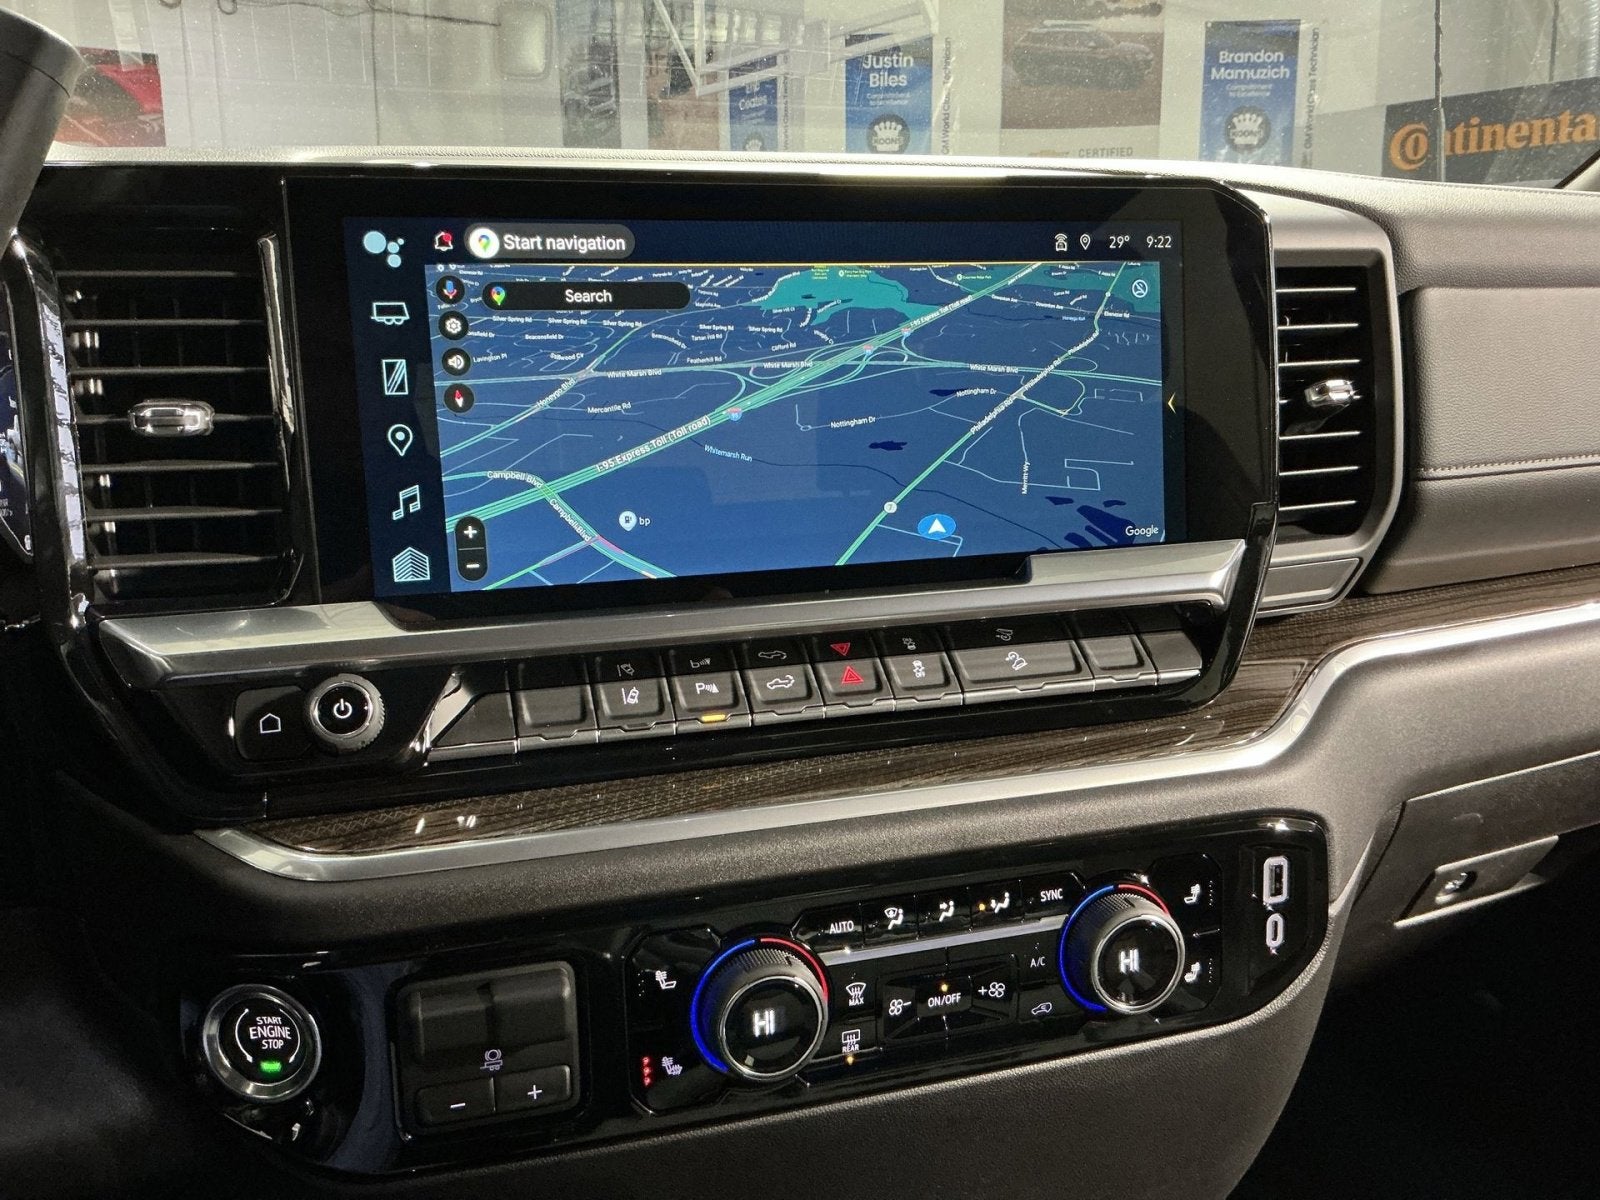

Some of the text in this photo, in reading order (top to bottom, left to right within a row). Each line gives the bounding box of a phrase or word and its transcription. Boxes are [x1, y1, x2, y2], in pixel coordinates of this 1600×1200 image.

[1218, 50, 1284, 63] Brandon
[1309, 27, 1320, 77] Technician
[863, 53, 914, 68] Justin
[869, 73, 908, 87] Biles
[1211, 66, 1290, 80] Mamuzich
[942, 112, 951, 137] World
[1078, 147, 1133, 158] CERTIFIED
[504, 235, 626, 253] Start navigation
[1146, 235, 1172, 249] 9:22
[565, 289, 613, 303] Search
[508, 316, 524, 324] Spring
[563, 318, 579, 326] Spring
[618, 320, 633, 328] Spring
[771, 343, 789, 351] Clifford
[473, 354, 500, 363] Lavington
[797, 360, 813, 368] Blvd
[607, 368, 662, 378] White Marsh Blvd
[970, 363, 1019, 373] White Marsh Blvd
[536, 377, 576, 408] Honeygo Blvd
[956, 388, 989, 398] Nottingham
[588, 401, 632, 413] Mercantile Rd
[830, 416, 876, 428] Nottingham Dr
[970, 395, 1013, 435] Philadelphia Rd
[595, 414, 711, 473] I-95 Express Toll (Toll road)
[704, 444, 753, 463] Whitemarsh Run
[487, 470, 543, 489] Campbell Blvd
[1021, 473, 1029, 495] Merritt
[549, 498, 592, 542] Campbell Blvd
[639, 516, 650, 527] bp
[1125, 524, 1159, 538] Google
[1040, 889, 1063, 902] SYNC
[829, 921, 854, 935] AUTO
[1030, 956, 1046, 968] A/C
[1119, 948, 1140, 975] HI
[848, 996, 864, 1006] MAX
[927, 992, 961, 1008] ON/OFF
[256, 1016, 282, 1025] START
[752, 1009, 776, 1038] HI
[249, 1026, 292, 1040] ENGINE
[261, 1039, 285, 1050] STOP
[842, 1043, 859, 1052] REAR
